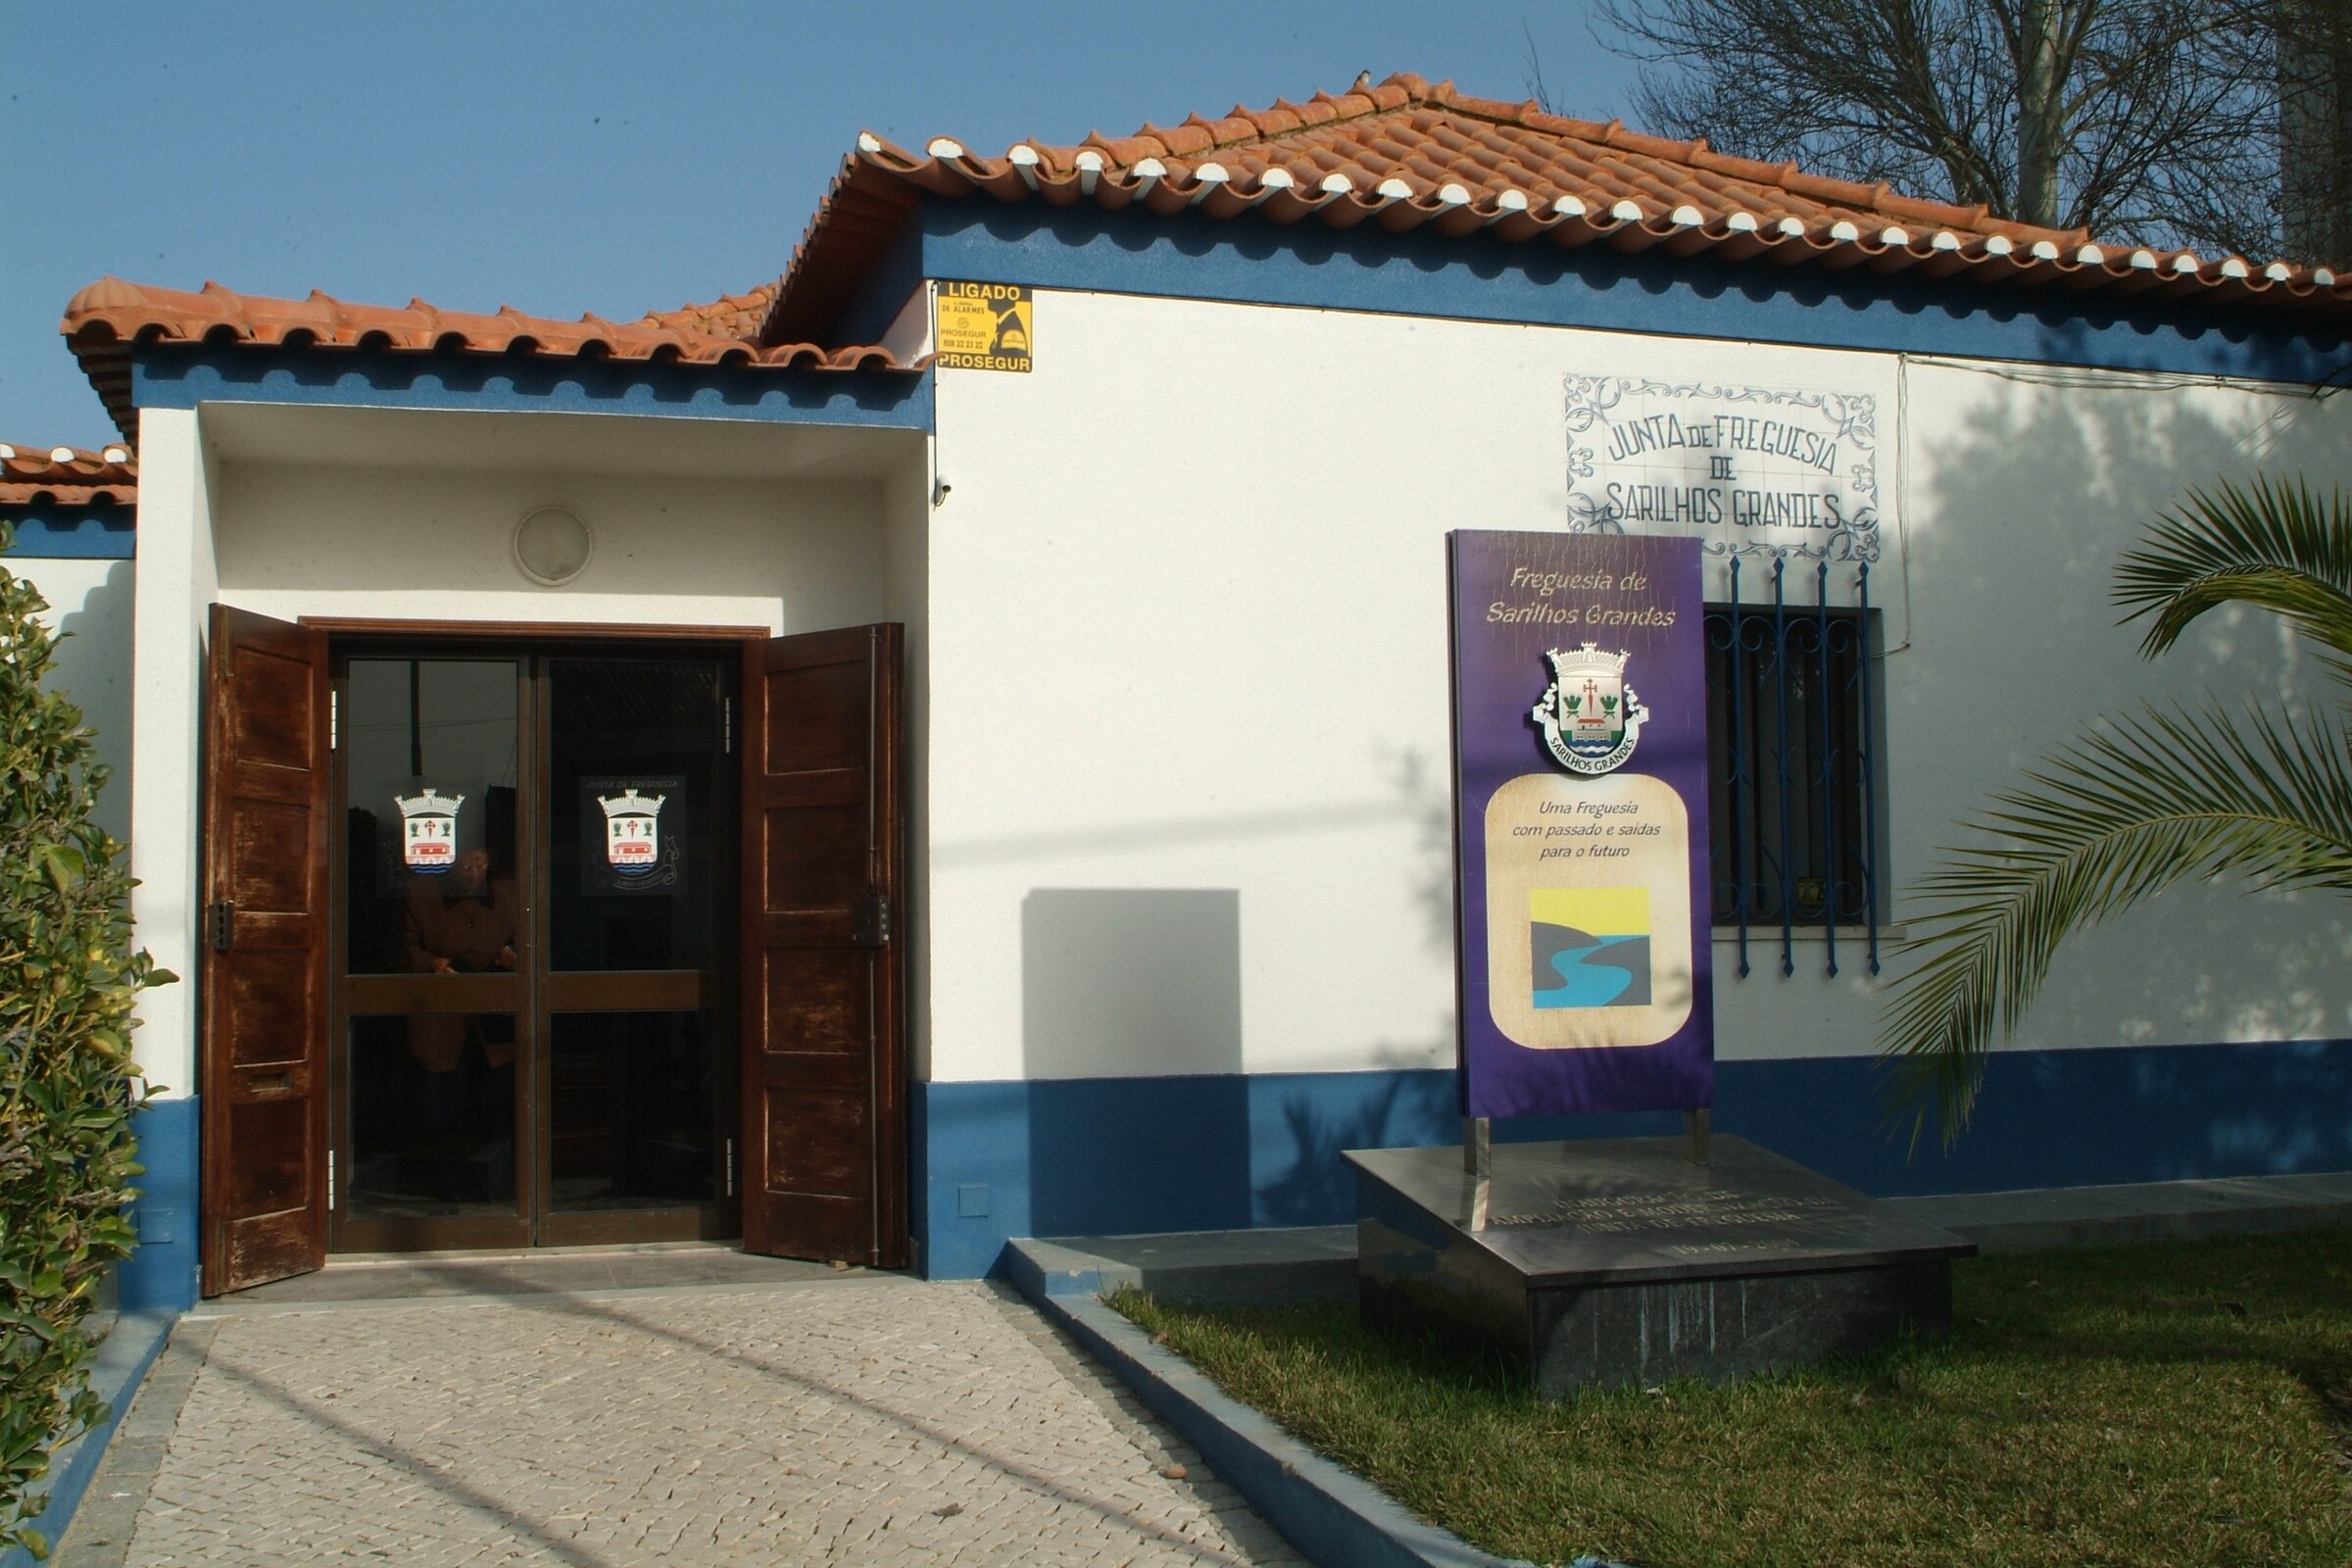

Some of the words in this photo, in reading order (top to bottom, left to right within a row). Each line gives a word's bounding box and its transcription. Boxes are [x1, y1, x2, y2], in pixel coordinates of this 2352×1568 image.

[949, 282, 1020, 301] LIGADO
[954, 306, 985, 315] ALARMES
[941, 328, 987, 338] PROSEGUR
[939, 354, 1030, 371] PROSEGUR
[1608, 413, 1686, 462] JUNTA
[1687, 424, 1712, 448] DE
[1713, 415, 1838, 475] FREGUESIA
[1709, 455, 1738, 481] DE
[1606, 482, 1722, 524] SARILHOS
[1733, 489, 1841, 530] GRANDES
[1510, 566, 1612, 596] Freguesia
[1620, 571, 1647, 591] de
[1487, 602, 1579, 624] Sarilhos
[1586, 605, 1677, 626] Grandes
[1549, 737, 1592, 771] SARILHOS
[1593, 737, 1635, 771] GRANDES
[1540, 801, 1572, 814] Uma
[1576, 801, 1640, 819] Freguesia
[1512, 826, 1543, 836] com
[1545, 823, 1602, 839] passado
[1606, 826, 1615, 836] e
[1540, 847, 1572, 861] para
[1576, 848, 1585, 858] o
[1589, 844, 1630, 858] futuro
[1615, 1208, 1635, 1218] E
[1574, 1221, 1648, 1235] JUNTA
[1648, 1217, 1683, 1229] DE
[1685, 1211, 1801, 1227] FREGUESIA
